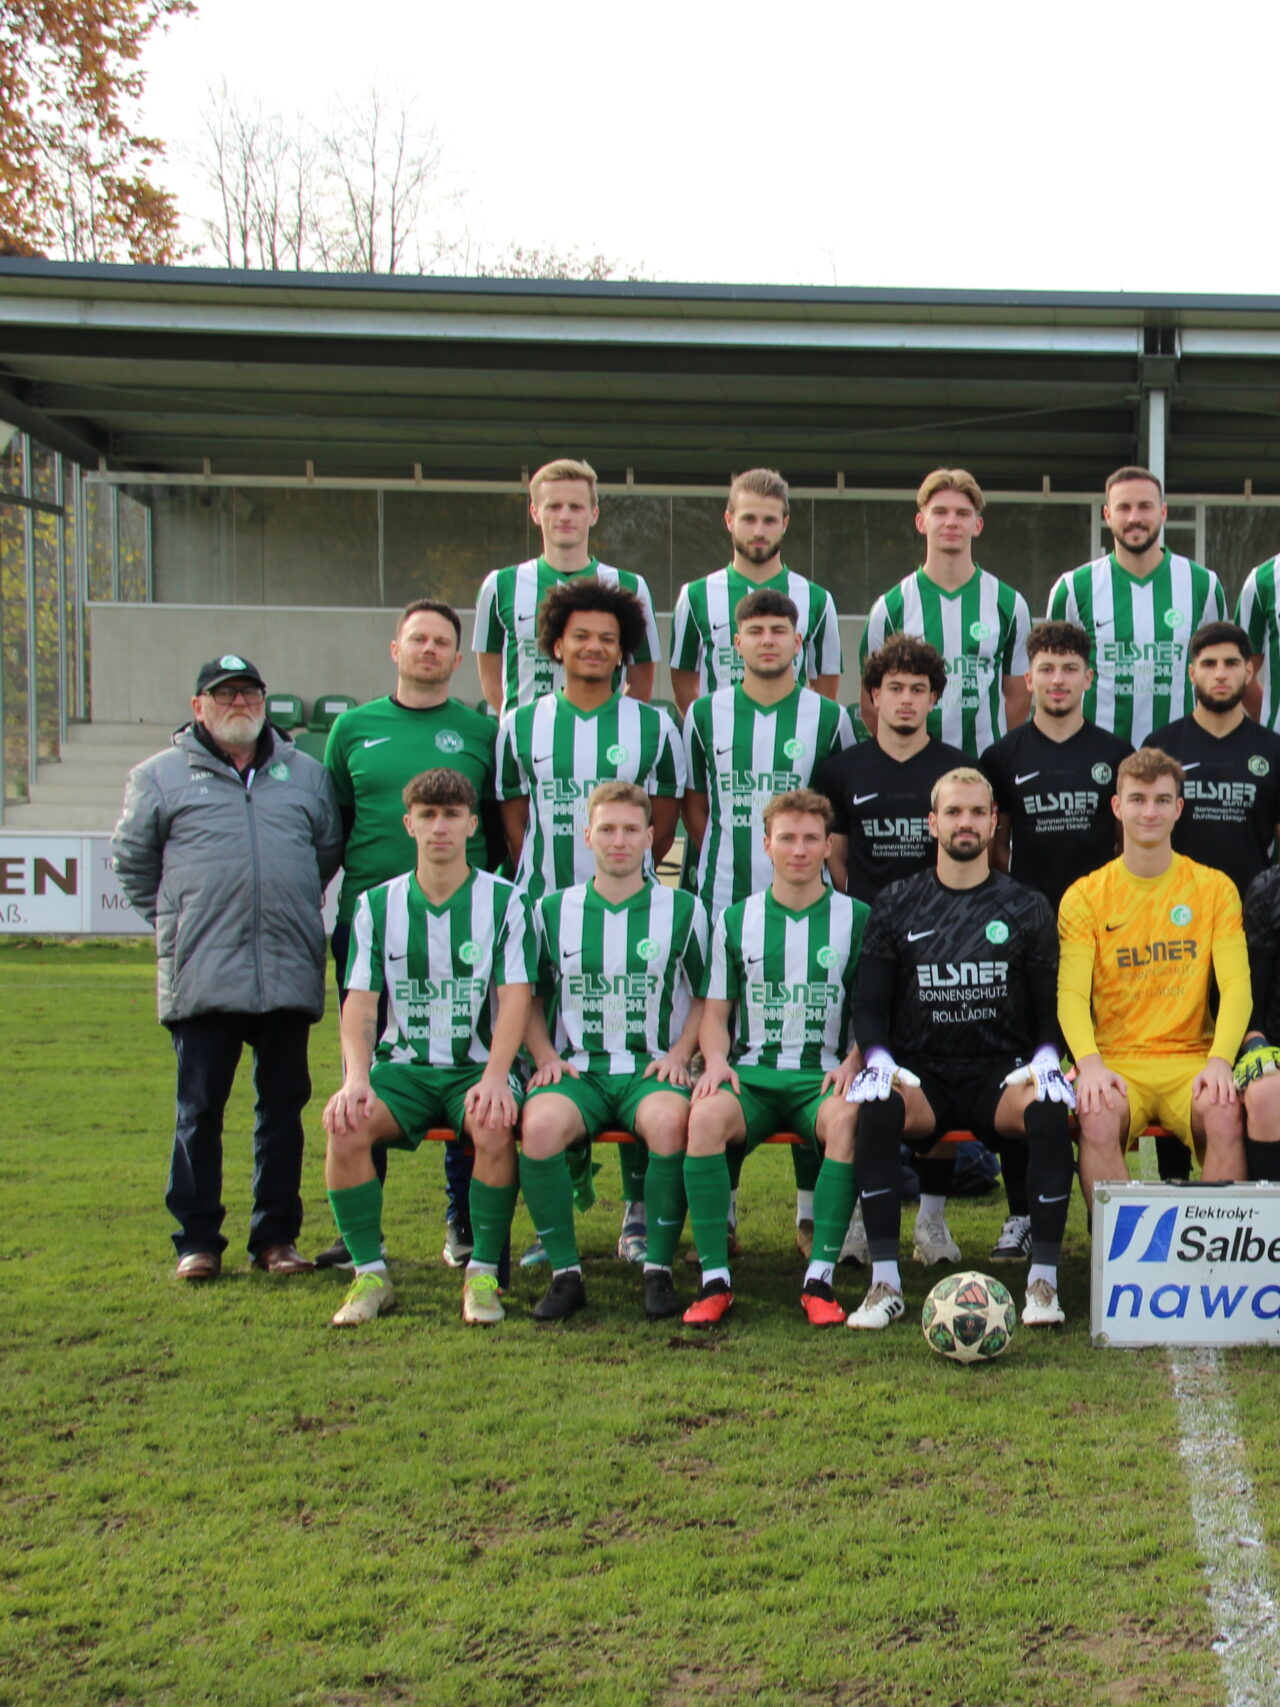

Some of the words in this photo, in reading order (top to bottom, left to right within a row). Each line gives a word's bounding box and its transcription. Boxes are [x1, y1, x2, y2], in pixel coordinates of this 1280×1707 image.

[1103, 641, 1184, 663] ELSNER
[719, 771, 803, 793] ELSNER
[1183, 780, 1257, 803] ELSNER
[1023, 791, 1099, 815] ELSNER
[568, 973, 659, 996] ELSNER
[916, 961, 1009, 988] ELSNER
[395, 977, 487, 1001] ELSNER
[751, 982, 840, 1007] ELSNER
[919, 984, 1007, 1002] SONNENSCHUTZ
